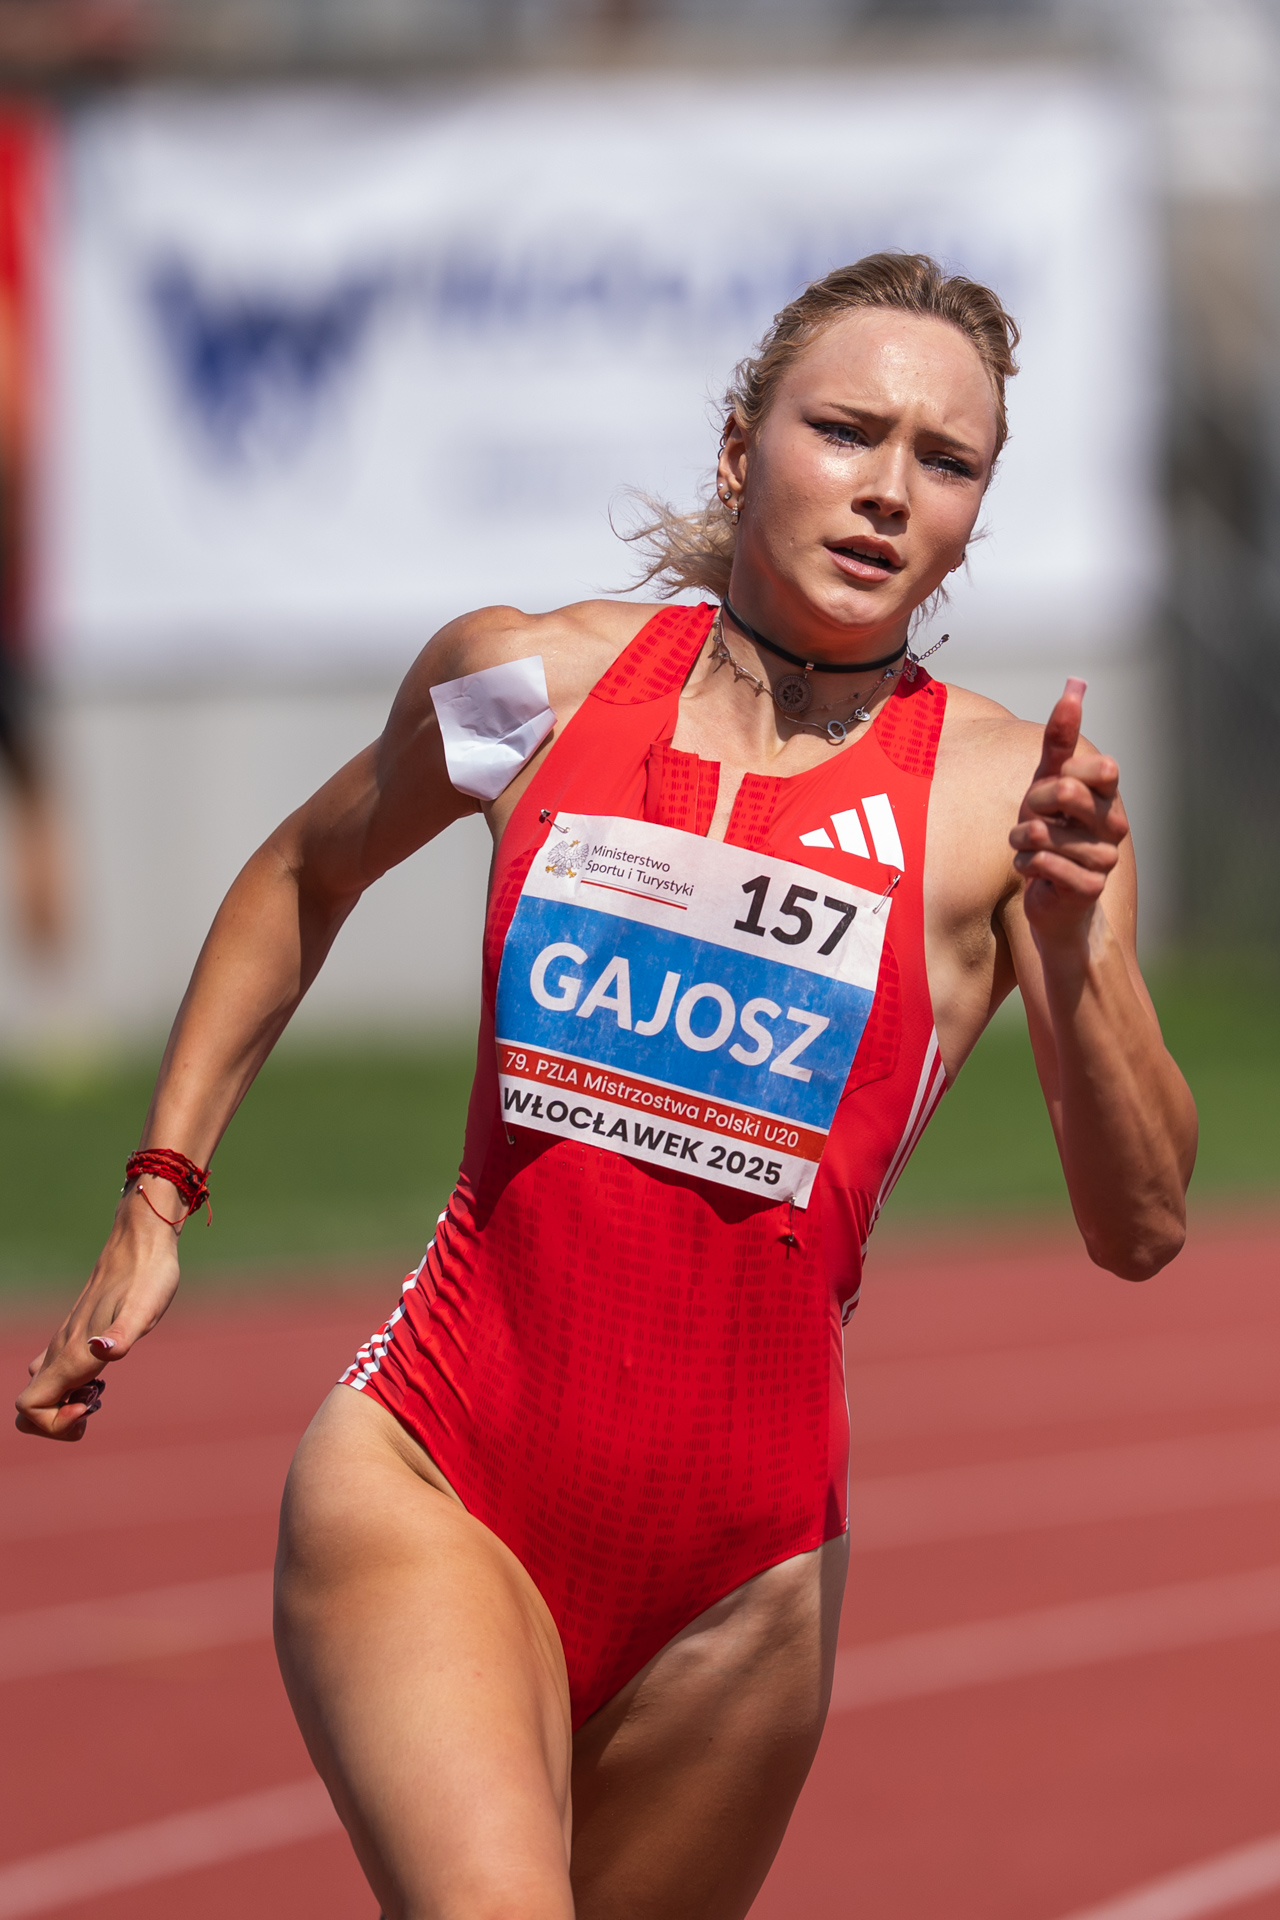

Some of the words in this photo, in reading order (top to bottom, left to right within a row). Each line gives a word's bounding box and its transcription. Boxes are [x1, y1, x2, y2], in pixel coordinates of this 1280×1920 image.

[585, 859, 626, 878] Sportu
[627, 868, 633, 880] i
[636, 869, 695, 897] Turystyki
[591, 845, 671, 873] Ministerstwo
[733, 874, 858, 956] 157
[529, 941, 831, 1083] GAJOSZ
[503, 1087, 704, 1164] WŁOCŁAWEK
[706, 1145, 783, 1186] 2025
[505, 1051, 530, 1073] 79.
[535, 1059, 578, 1085] PZLA
[583, 1072, 700, 1120] Mistrzostwa
[703, 1107, 762, 1138] Polski
[764, 1124, 799, 1148] U20
